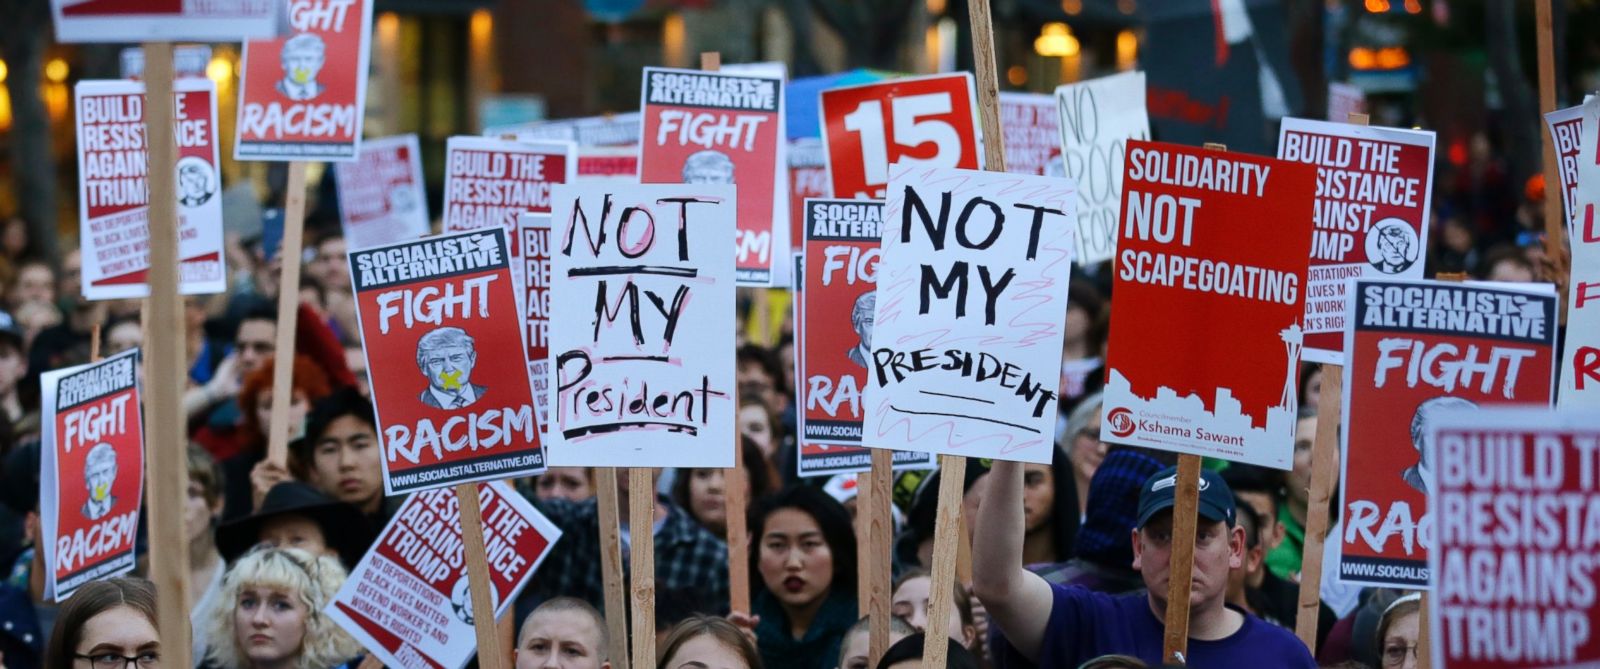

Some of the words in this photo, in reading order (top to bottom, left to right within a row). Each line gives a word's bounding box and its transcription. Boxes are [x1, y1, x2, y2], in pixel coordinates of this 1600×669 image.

[650, 72, 750, 95] SOCIALIST
[650, 86, 776, 110] ALTERNATIVE
[82, 95, 142, 124] BUILD
[241, 102, 356, 138] RACISM
[657, 109, 768, 152] FIGHT
[1059, 84, 1099, 145] NO
[86, 150, 149, 179] AGAIN
[844, 92, 963, 188] 15
[1285, 133, 1353, 168] BUILD
[1357, 141, 1402, 175] THE
[452, 150, 508, 178] BUILD
[509, 154, 546, 181] THE
[1128, 147, 1271, 198] SOLIDARITY
[86, 178, 149, 208] TRUM
[450, 178, 552, 209] RESISTANC
[562, 193, 721, 261] NOT
[901, 184, 1066, 261] NOT
[1124, 190, 1202, 247] NOT
[357, 235, 472, 272] SOCIALIST
[361, 247, 502, 288] ALTERNATIVE
[821, 245, 882, 287] FIG
[1120, 248, 1299, 306] SCAPEGOATING
[376, 274, 499, 335] FIGHT
[591, 279, 691, 349] MY
[918, 261, 1016, 327] MY
[1307, 283, 1335, 298] LIVES
[1364, 285, 1511, 316] SOCIALIST
[1363, 305, 1546, 340] ALTERNATIVE
[58, 371, 134, 410] ALTERNATIVE
[556, 350, 729, 425] President
[872, 348, 1057, 418] PRESIDENT
[1373, 337, 1537, 400] FIGHT
[64, 393, 131, 453] FIGHT
[384, 404, 535, 465] RACISM
[1138, 418, 1192, 438] Kshama
[1195, 427, 1245, 447] Sawant
[1139, 409, 1193, 424] Councilmember
[391, 453, 543, 488] WWW.SOCIALISTALTERNATIVE.ORG
[1440, 433, 1565, 490] BUILD
[56, 510, 137, 573] RACISM
[485, 499, 529, 546] THE
[385, 521, 451, 585] TRUMP
[362, 569, 390, 593] BLACK
[390, 583, 415, 607] LIVES
[415, 597, 450, 627] MATTER!
[369, 555, 383, 570] NO
[382, 562, 444, 608] DEPORTATIONS!
[350, 595, 389, 626] WOMEN'S
[389, 618, 423, 644] RIGHTS!
[356, 581, 390, 610] DEFEND
[389, 599, 432, 635] WORKER'S
[431, 626, 450, 646] AND
[1440, 605, 1590, 664] TRUMP
